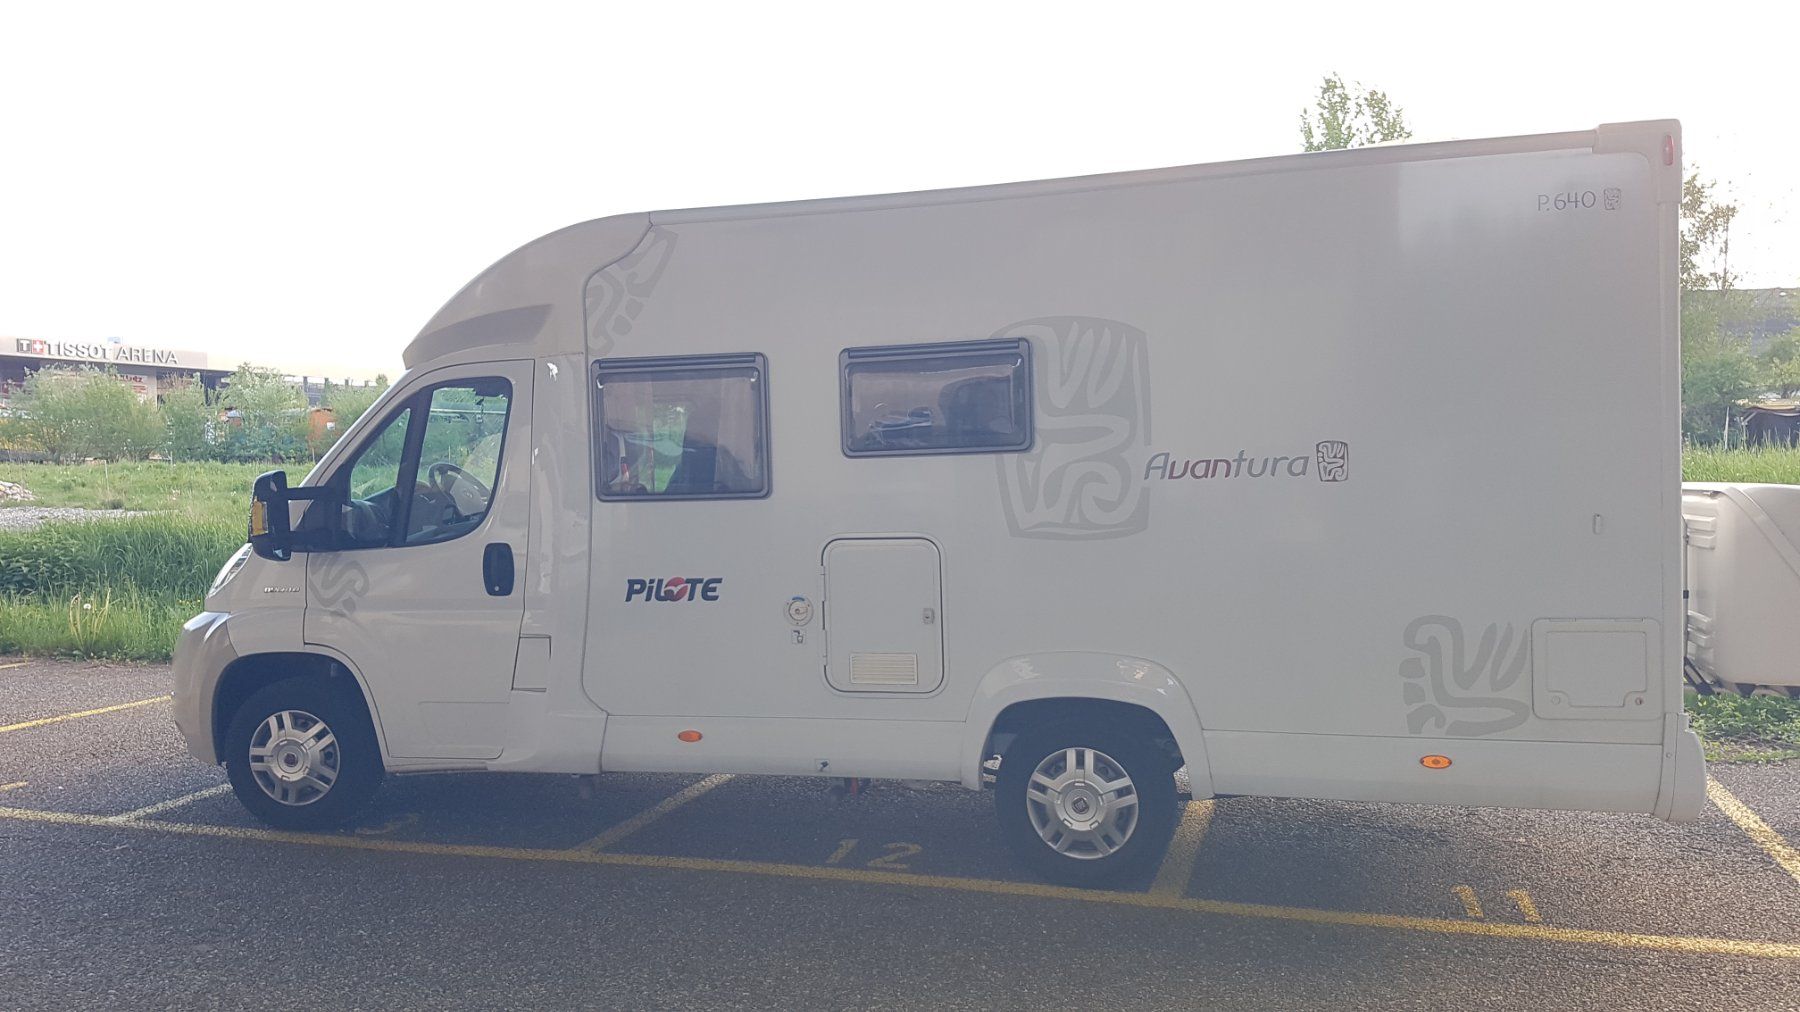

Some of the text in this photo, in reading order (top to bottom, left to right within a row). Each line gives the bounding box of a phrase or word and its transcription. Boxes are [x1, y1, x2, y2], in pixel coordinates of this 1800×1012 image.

[45, 340, 114, 360] TISSOT
[115, 346, 178, 365] ARENA
[1144, 449, 1310, 480] Avantura
